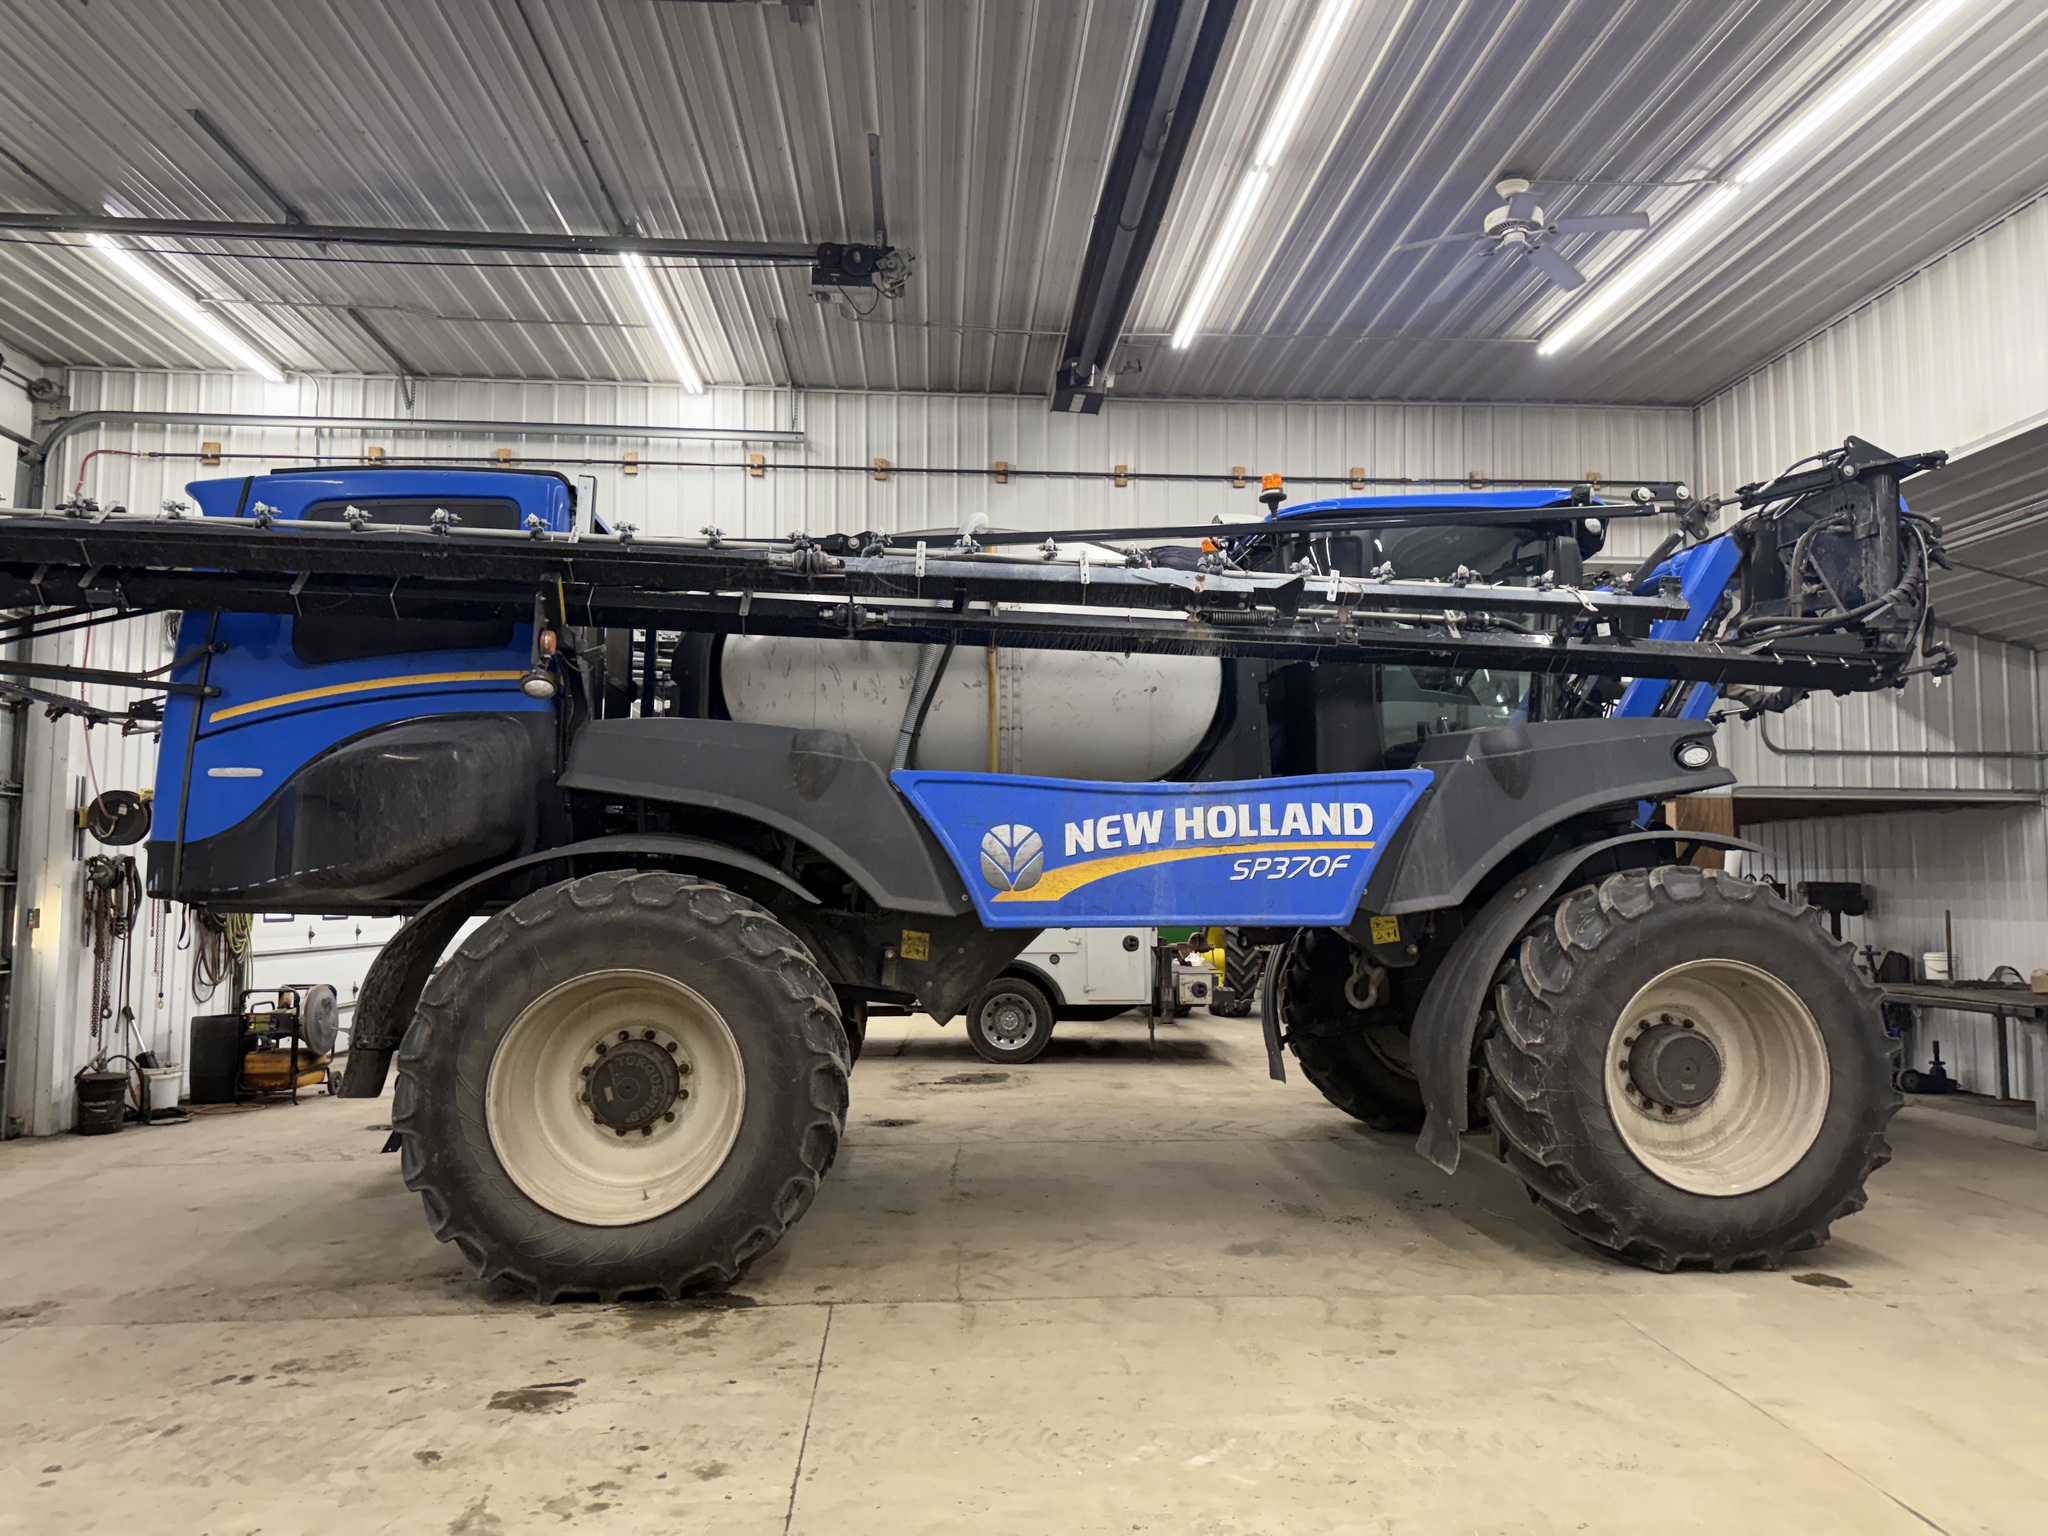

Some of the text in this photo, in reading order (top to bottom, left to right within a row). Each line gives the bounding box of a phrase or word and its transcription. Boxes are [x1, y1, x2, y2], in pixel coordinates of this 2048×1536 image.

[1065, 802, 1374, 857] NEW HOLLAND
[1229, 854, 1352, 881] SP370F
